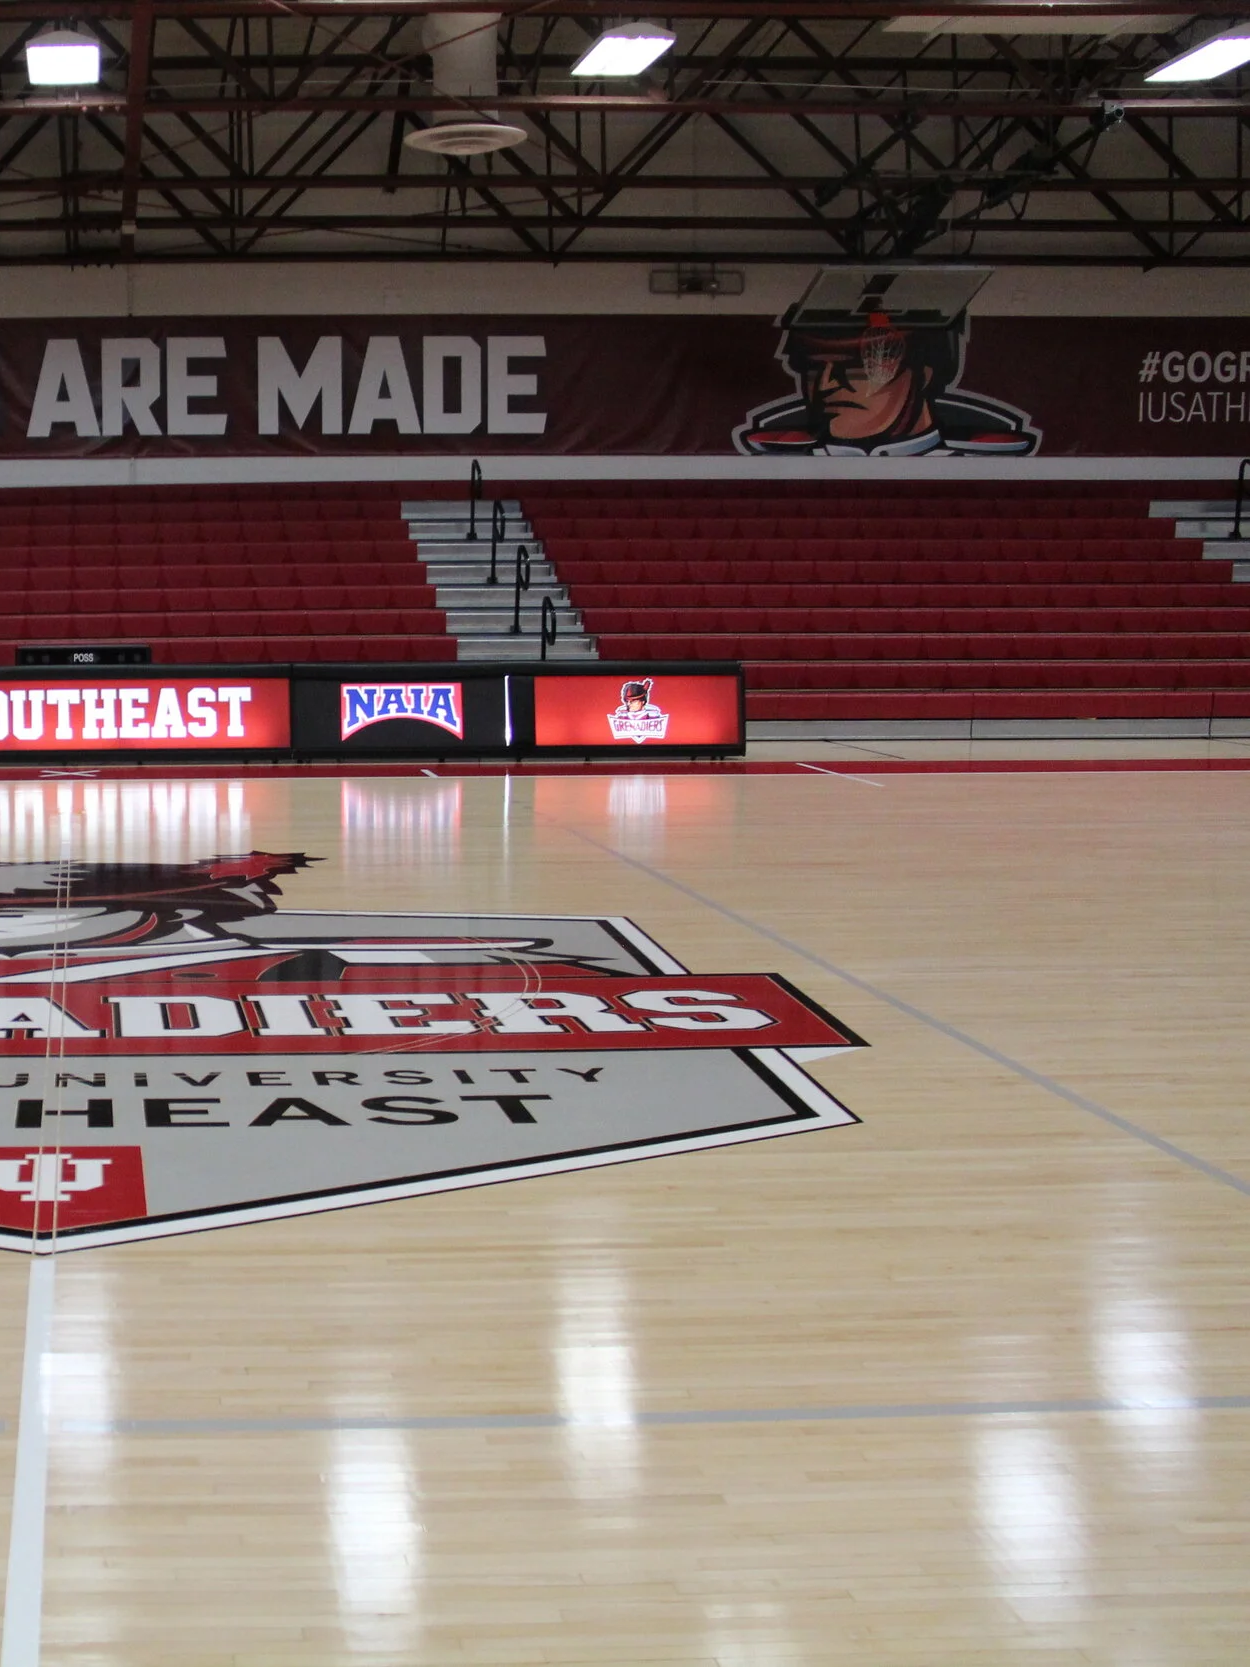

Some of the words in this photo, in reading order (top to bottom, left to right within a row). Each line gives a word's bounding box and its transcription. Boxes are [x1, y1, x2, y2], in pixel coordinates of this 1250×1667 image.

[27, 337, 228, 437] ARE
[257, 335, 548, 434] MADE
[1139, 391, 1250, 422] IUSATH
[73, 653, 94, 662] POSS
[346, 688, 457, 728] NAIA
